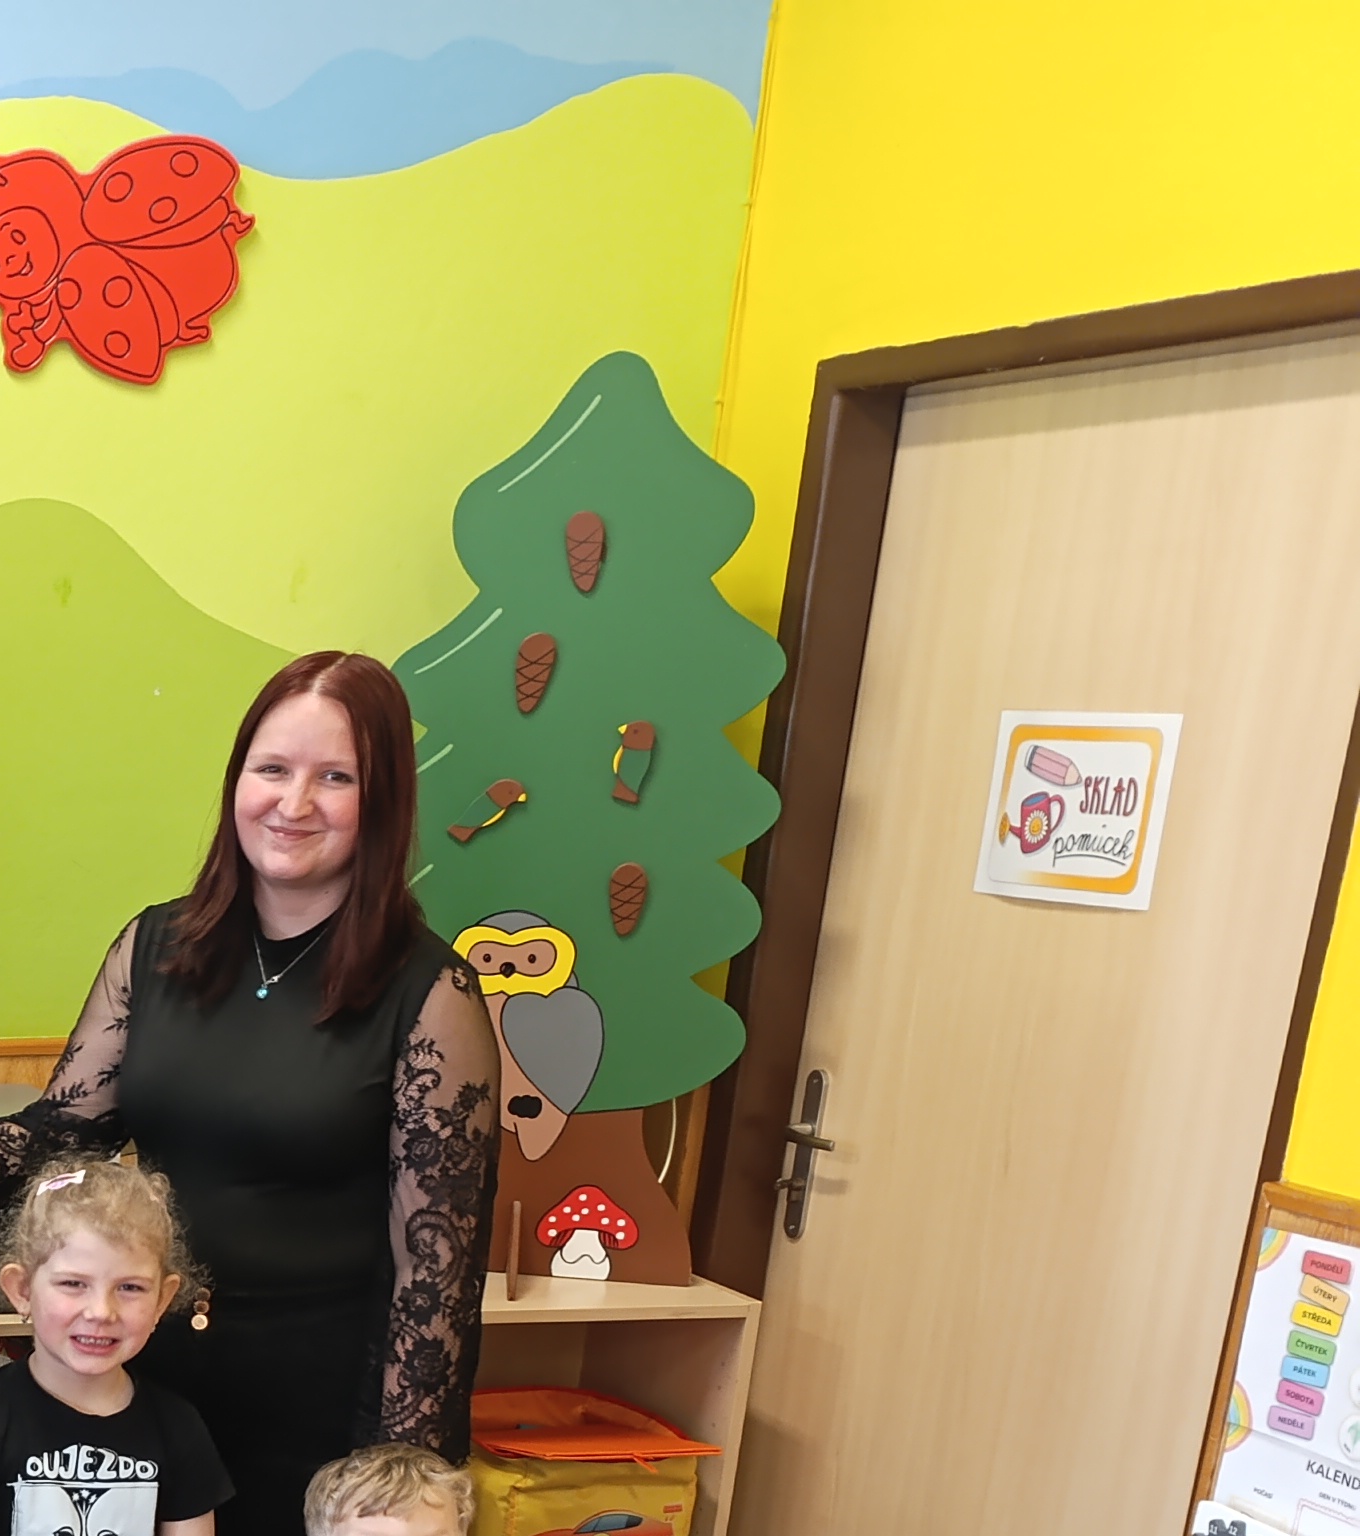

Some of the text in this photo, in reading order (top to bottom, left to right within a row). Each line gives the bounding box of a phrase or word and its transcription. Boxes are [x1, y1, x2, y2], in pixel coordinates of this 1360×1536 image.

[1079, 775, 1139, 817] SKLAD
[1310, 1257, 1344, 1275] PONDĚLÍ
[1312, 1284, 1338, 1304] ÚTERÝ
[1301, 1309, 1333, 1328] STŘEDA
[1294, 1338, 1328, 1357] ČTVRTEK
[1292, 1363, 1318, 1378] PÁTEK
[1285, 1388, 1315, 1407] SOBOTA
[1277, 1414, 1305, 1431] NEDĚLE
[25, 1443, 159, 1481] OUJEZDO
[1208, 1524, 1219, 1535] 11
[1228, 1526, 1238, 1536] 12
